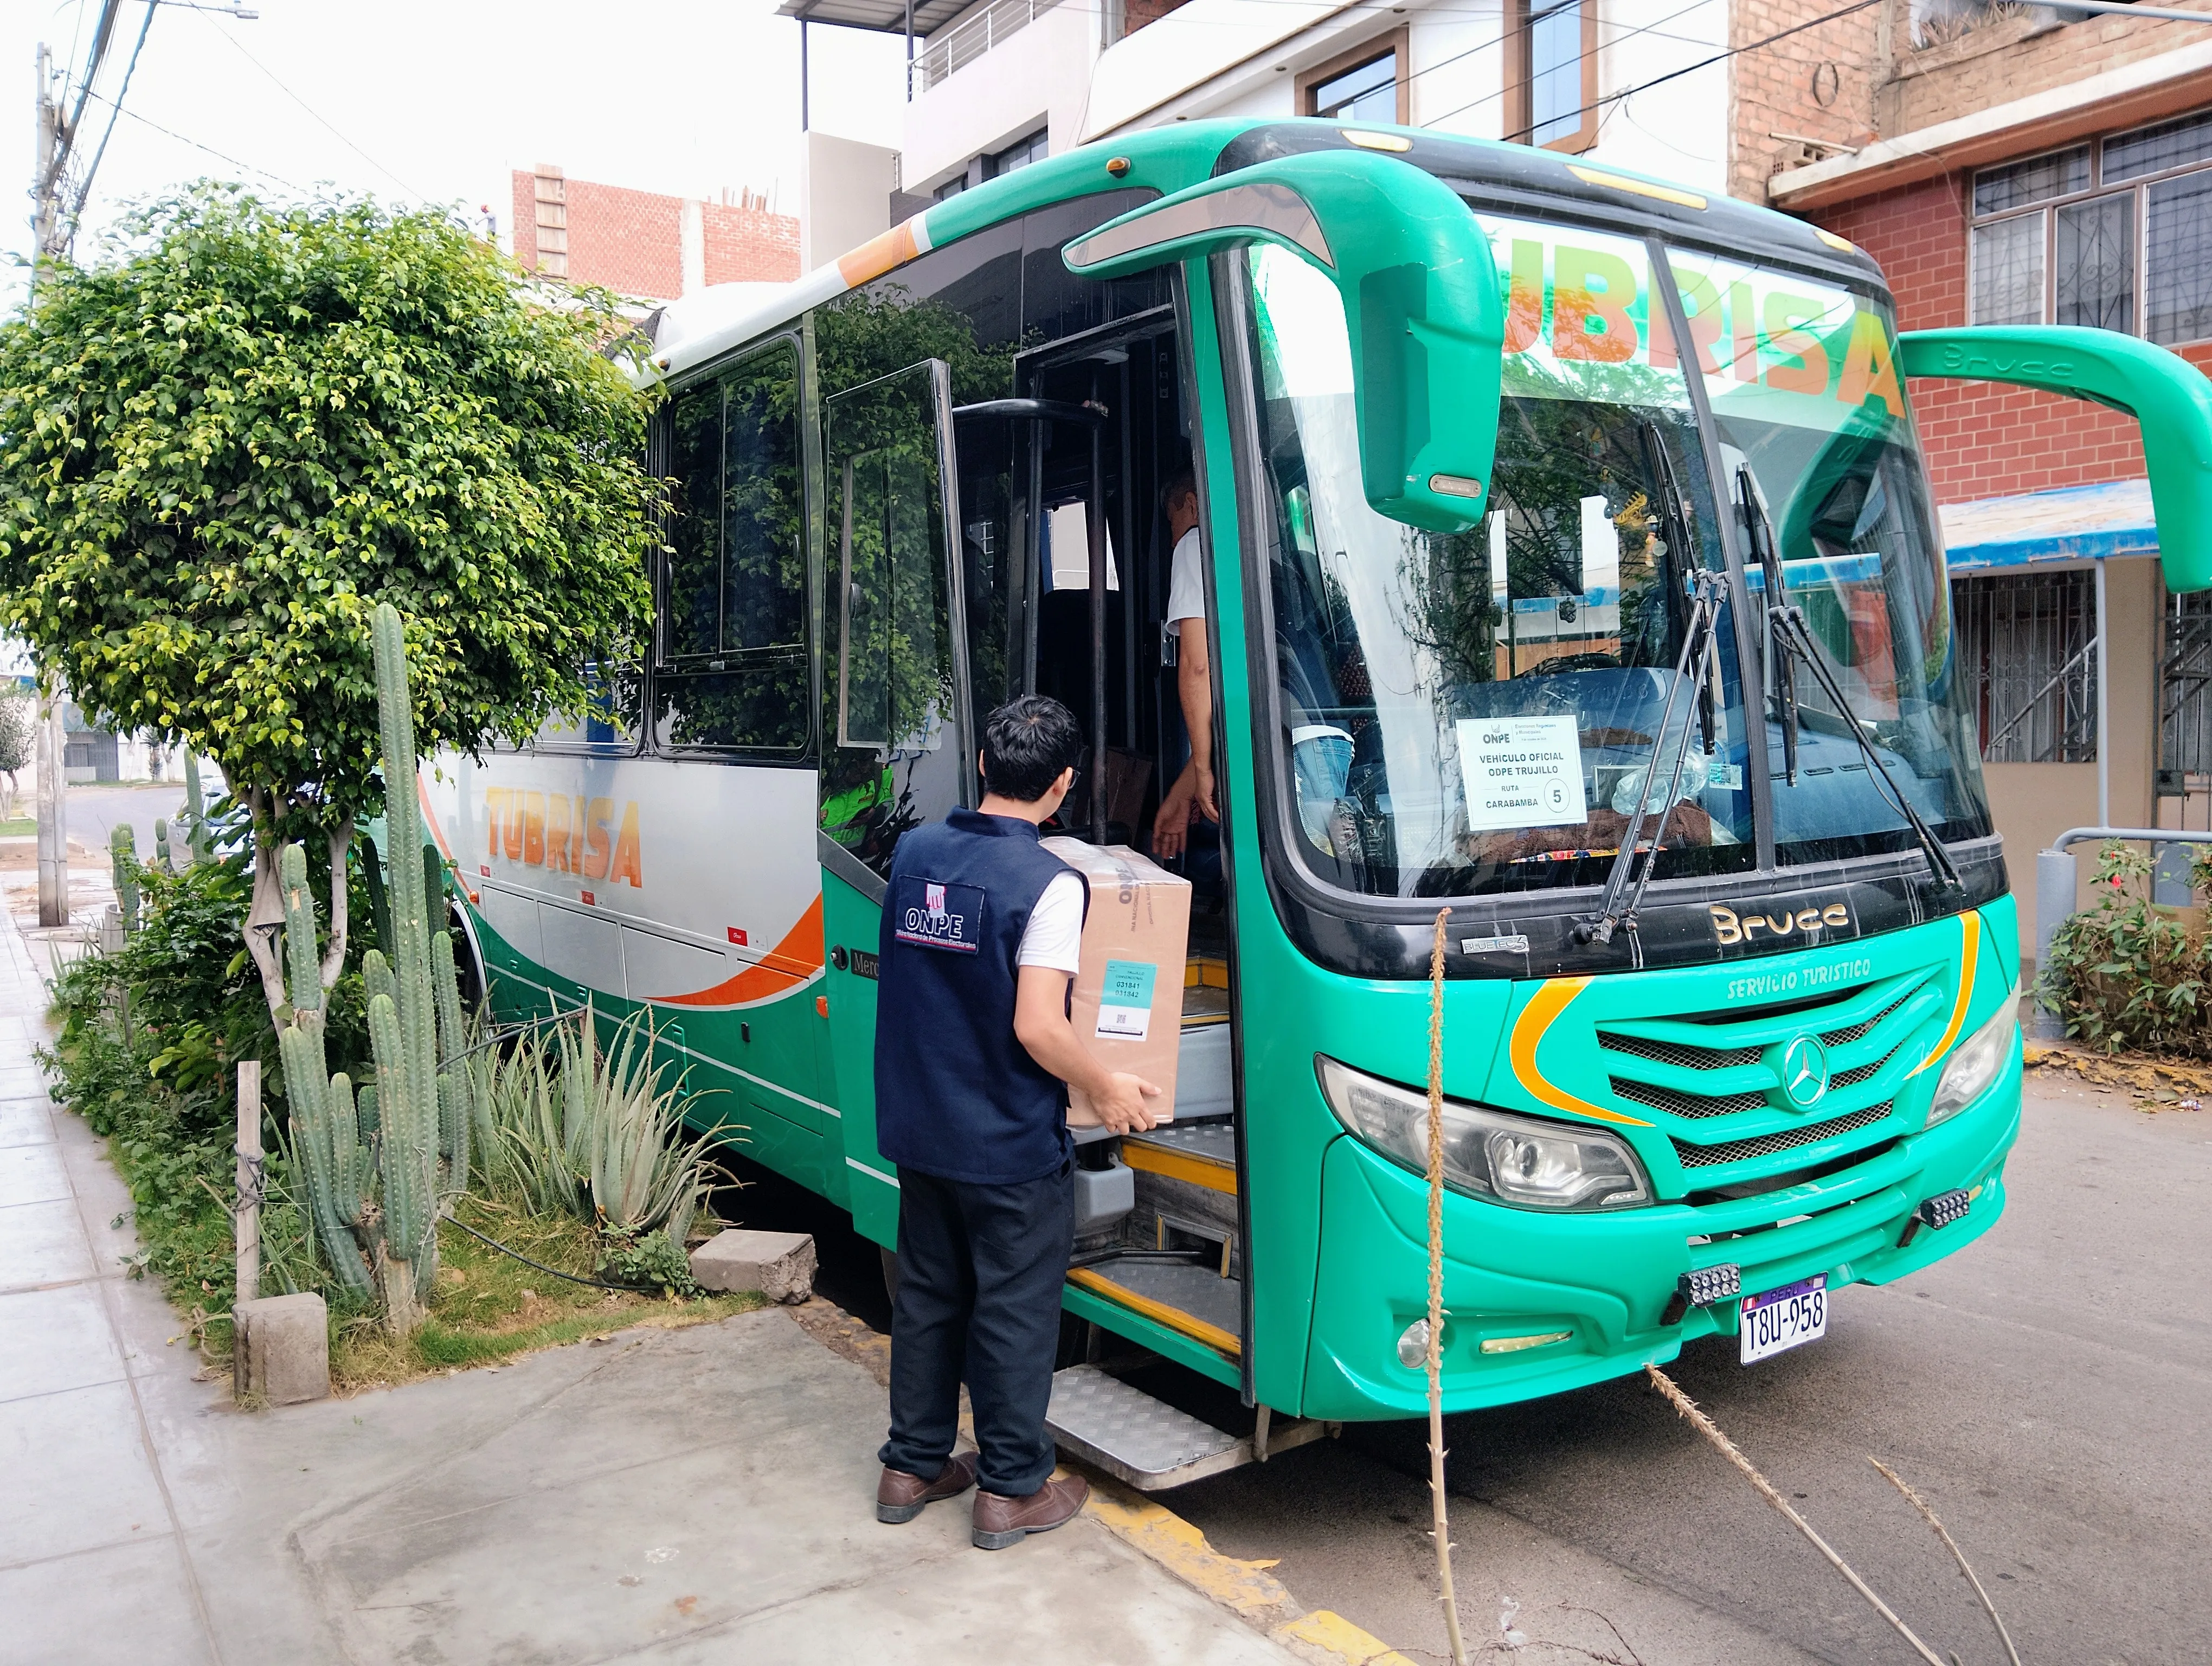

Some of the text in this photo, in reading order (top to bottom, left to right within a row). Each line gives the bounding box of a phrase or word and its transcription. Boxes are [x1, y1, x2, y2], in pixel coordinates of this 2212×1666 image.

[1501, 238, 1906, 420] UBRISA
[1483, 733, 1510, 744] ONPE
[1480, 752, 1564, 764] VEHÍCULO OFICIAL
[1489, 765, 1558, 777] ODPE TRUJILLO
[1486, 798, 1539, 809] CARABAMBA
[1553, 789, 1562, 804] 5
[486, 786, 643, 888] TUBRISA
[905, 907, 964, 939] ONPE
[1709, 903, 1849, 945] Bruce
[854, 952, 879, 976] Merc
[1802, 958, 1871, 988] TURISTICO
[1115, 990, 1139, 998] 031842
[1116, 981, 1140, 989] 031841
[1746, 1291, 1823, 1351] T8U-958
